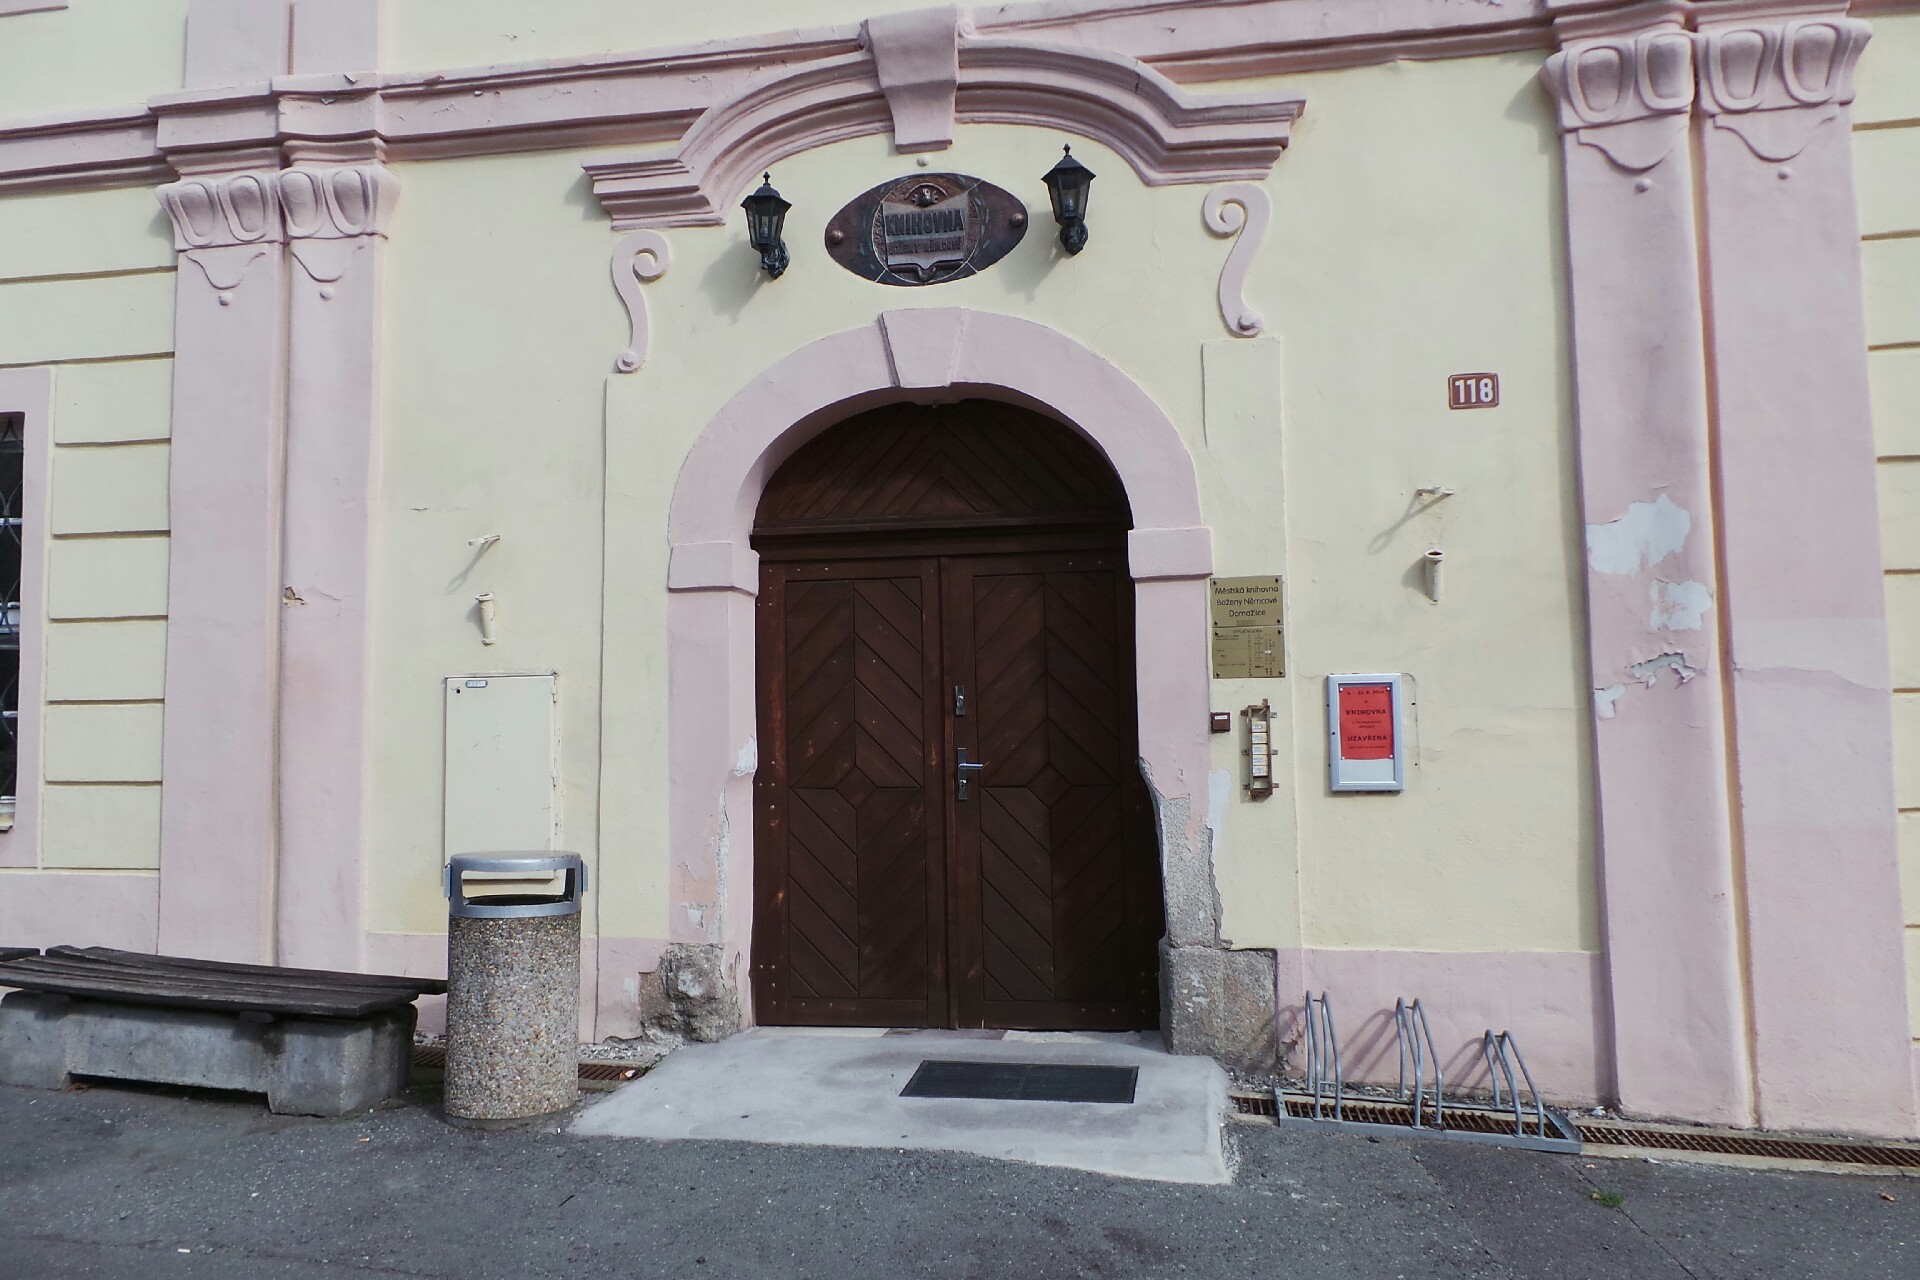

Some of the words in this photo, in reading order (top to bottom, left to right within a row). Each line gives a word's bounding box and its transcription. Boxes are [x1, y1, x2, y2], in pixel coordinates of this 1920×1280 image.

[885, 209, 964, 236] KNIHOVNA
[1455, 378, 1493, 403] 118
[1214, 587, 1245, 595] Městská
[1246, 585, 1279, 594] knihovna
[1216, 598, 1243, 606] Boženy
[1244, 596, 1278, 605] Němcové
[1228, 609, 1267, 617] Domažlice
[1347, 734, 1388, 742] UZAVŘENA
